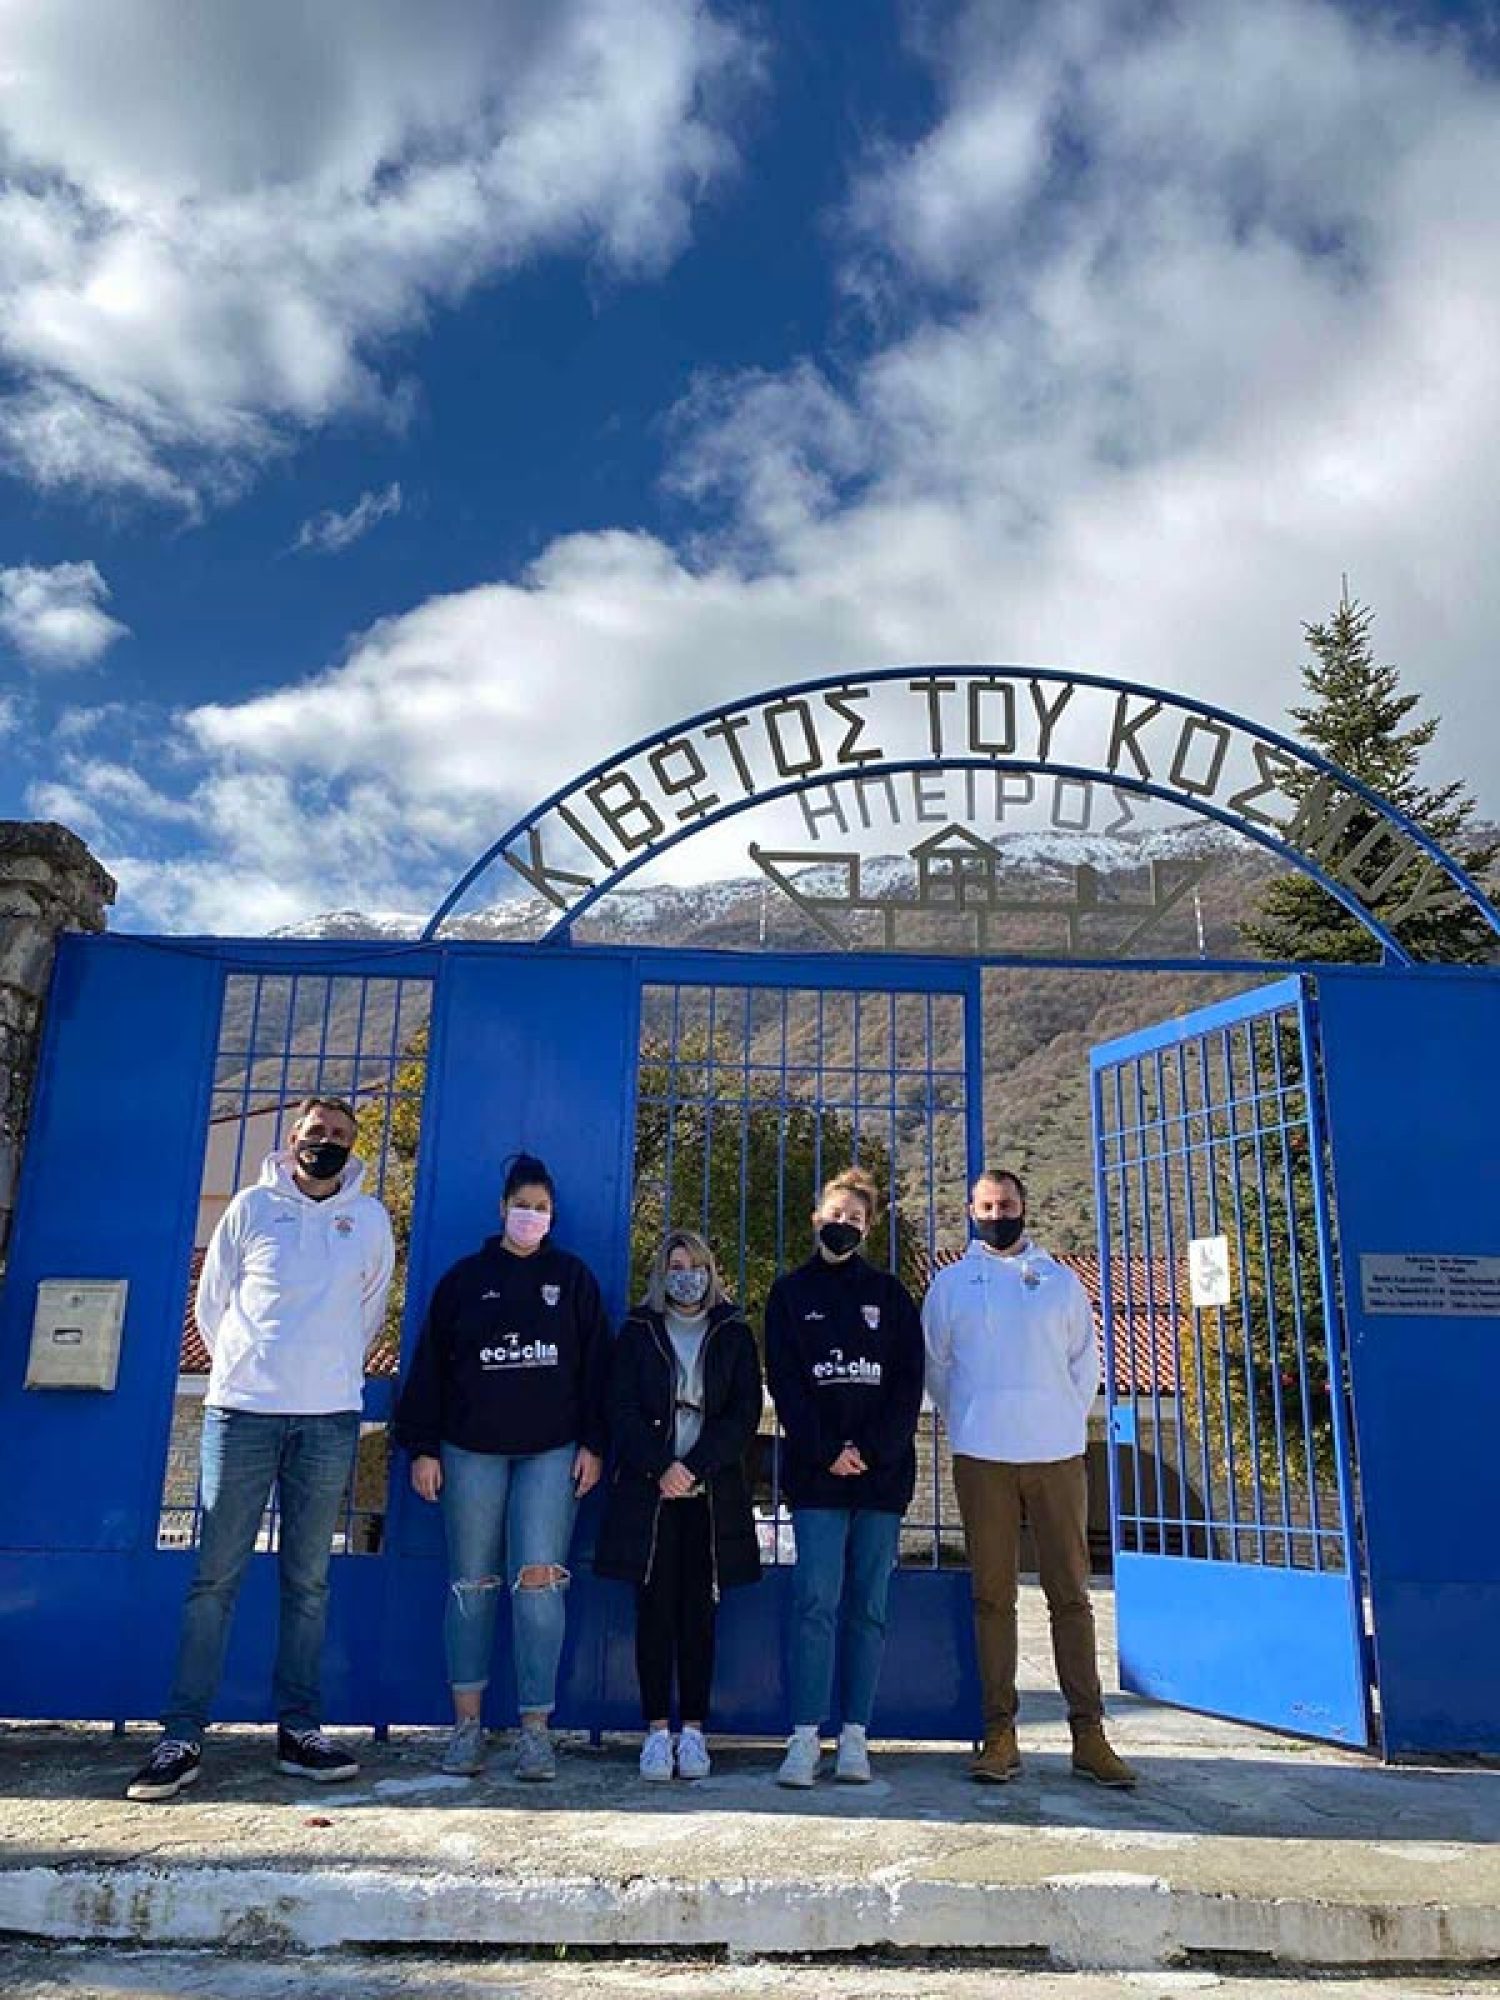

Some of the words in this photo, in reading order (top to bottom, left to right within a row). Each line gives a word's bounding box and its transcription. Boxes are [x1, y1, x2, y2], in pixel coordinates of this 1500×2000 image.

[502, 686, 884, 910] ΚΙΒΩΤΟΣ
[909, 680, 1074, 758] ΤΟΥ
[1106, 692, 1463, 925] ΚΟΣΜΟΥ
[797, 770, 1152, 841] ΗΠΕΙΡΟΣ
